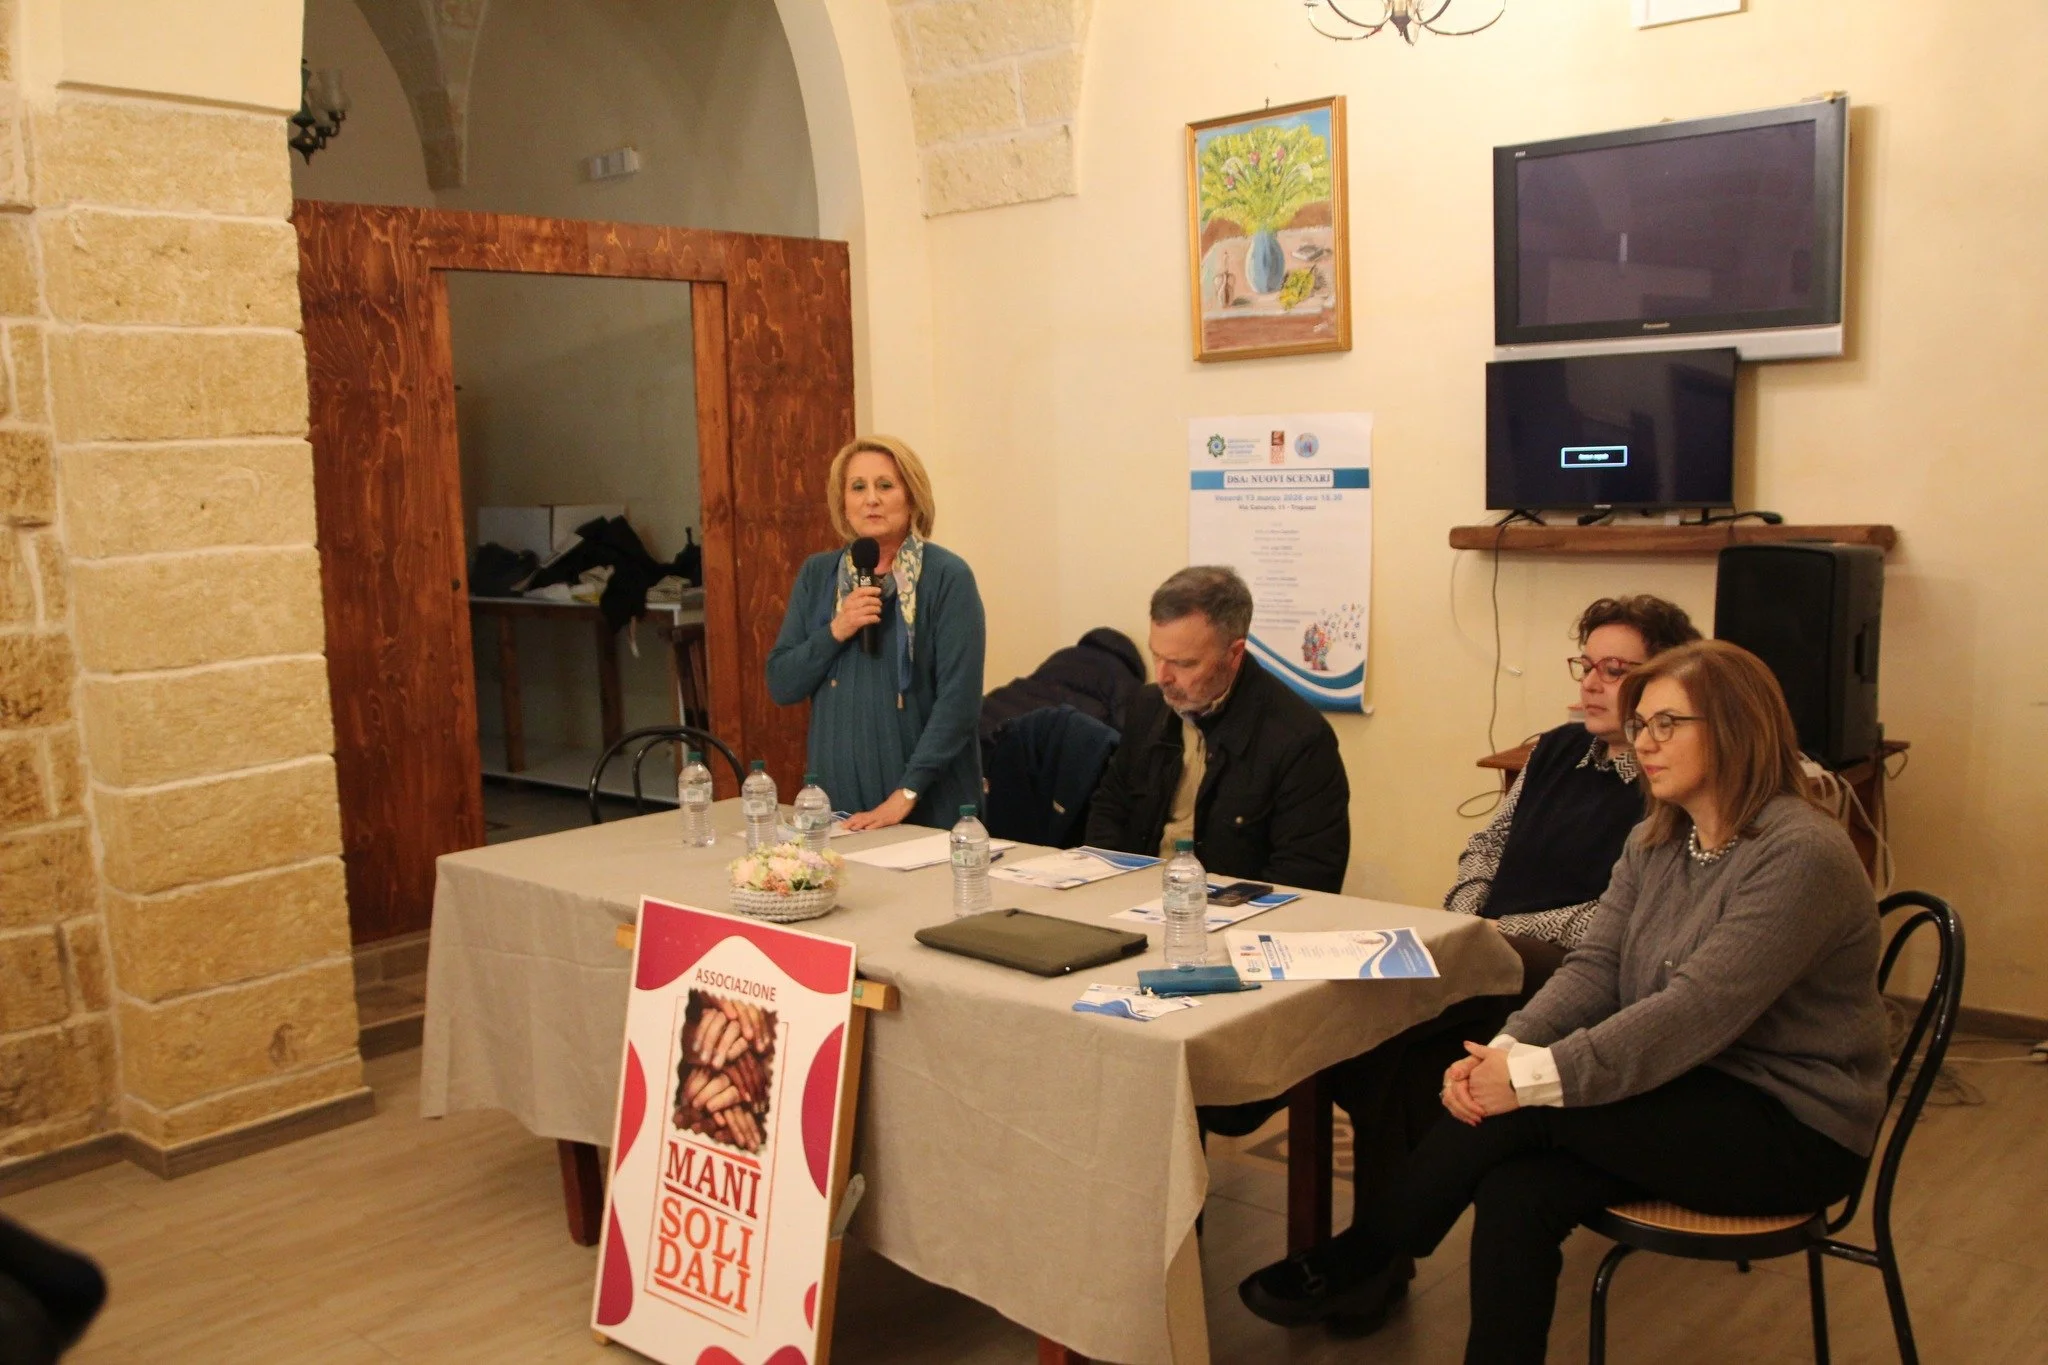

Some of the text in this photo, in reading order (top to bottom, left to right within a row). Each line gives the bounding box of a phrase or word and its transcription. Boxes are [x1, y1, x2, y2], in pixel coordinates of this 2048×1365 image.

[1227, 473, 1331, 484] DSA: NUOVI SCENARI
[695, 968, 777, 1002] ASSOCIAZIONE
[665, 1140, 762, 1220] MANI
[660, 1196, 754, 1271] SOLI
[654, 1235, 751, 1314] DALI
